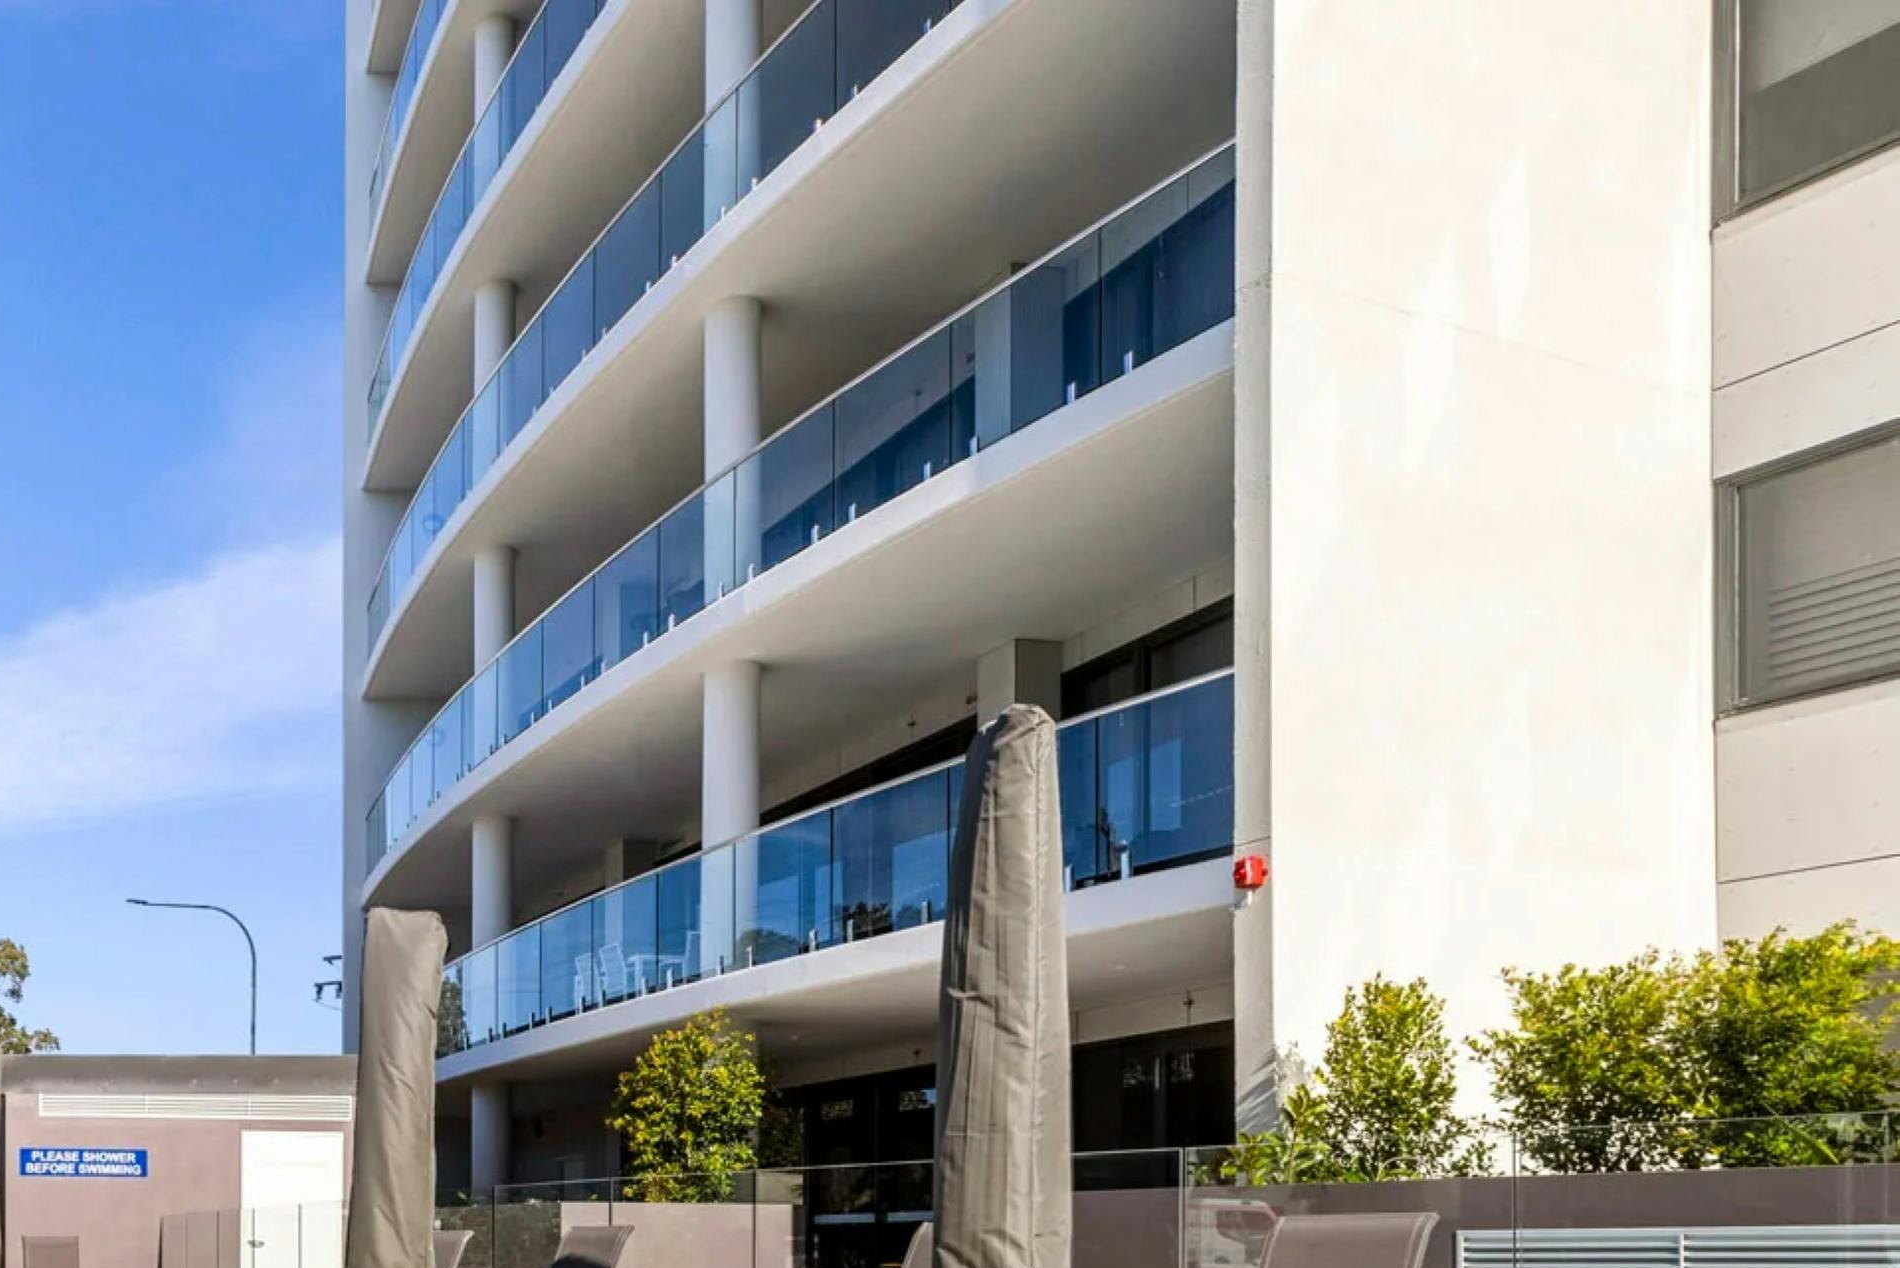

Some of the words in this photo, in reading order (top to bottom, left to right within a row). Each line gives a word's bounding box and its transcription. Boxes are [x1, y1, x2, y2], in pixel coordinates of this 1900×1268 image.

[30, 1151, 80, 1162] PLEASE
[82, 1152, 137, 1164] SHOWER
[25, 1162, 75, 1173] BEFORE
[78, 1163, 142, 1175] SWIMMING
